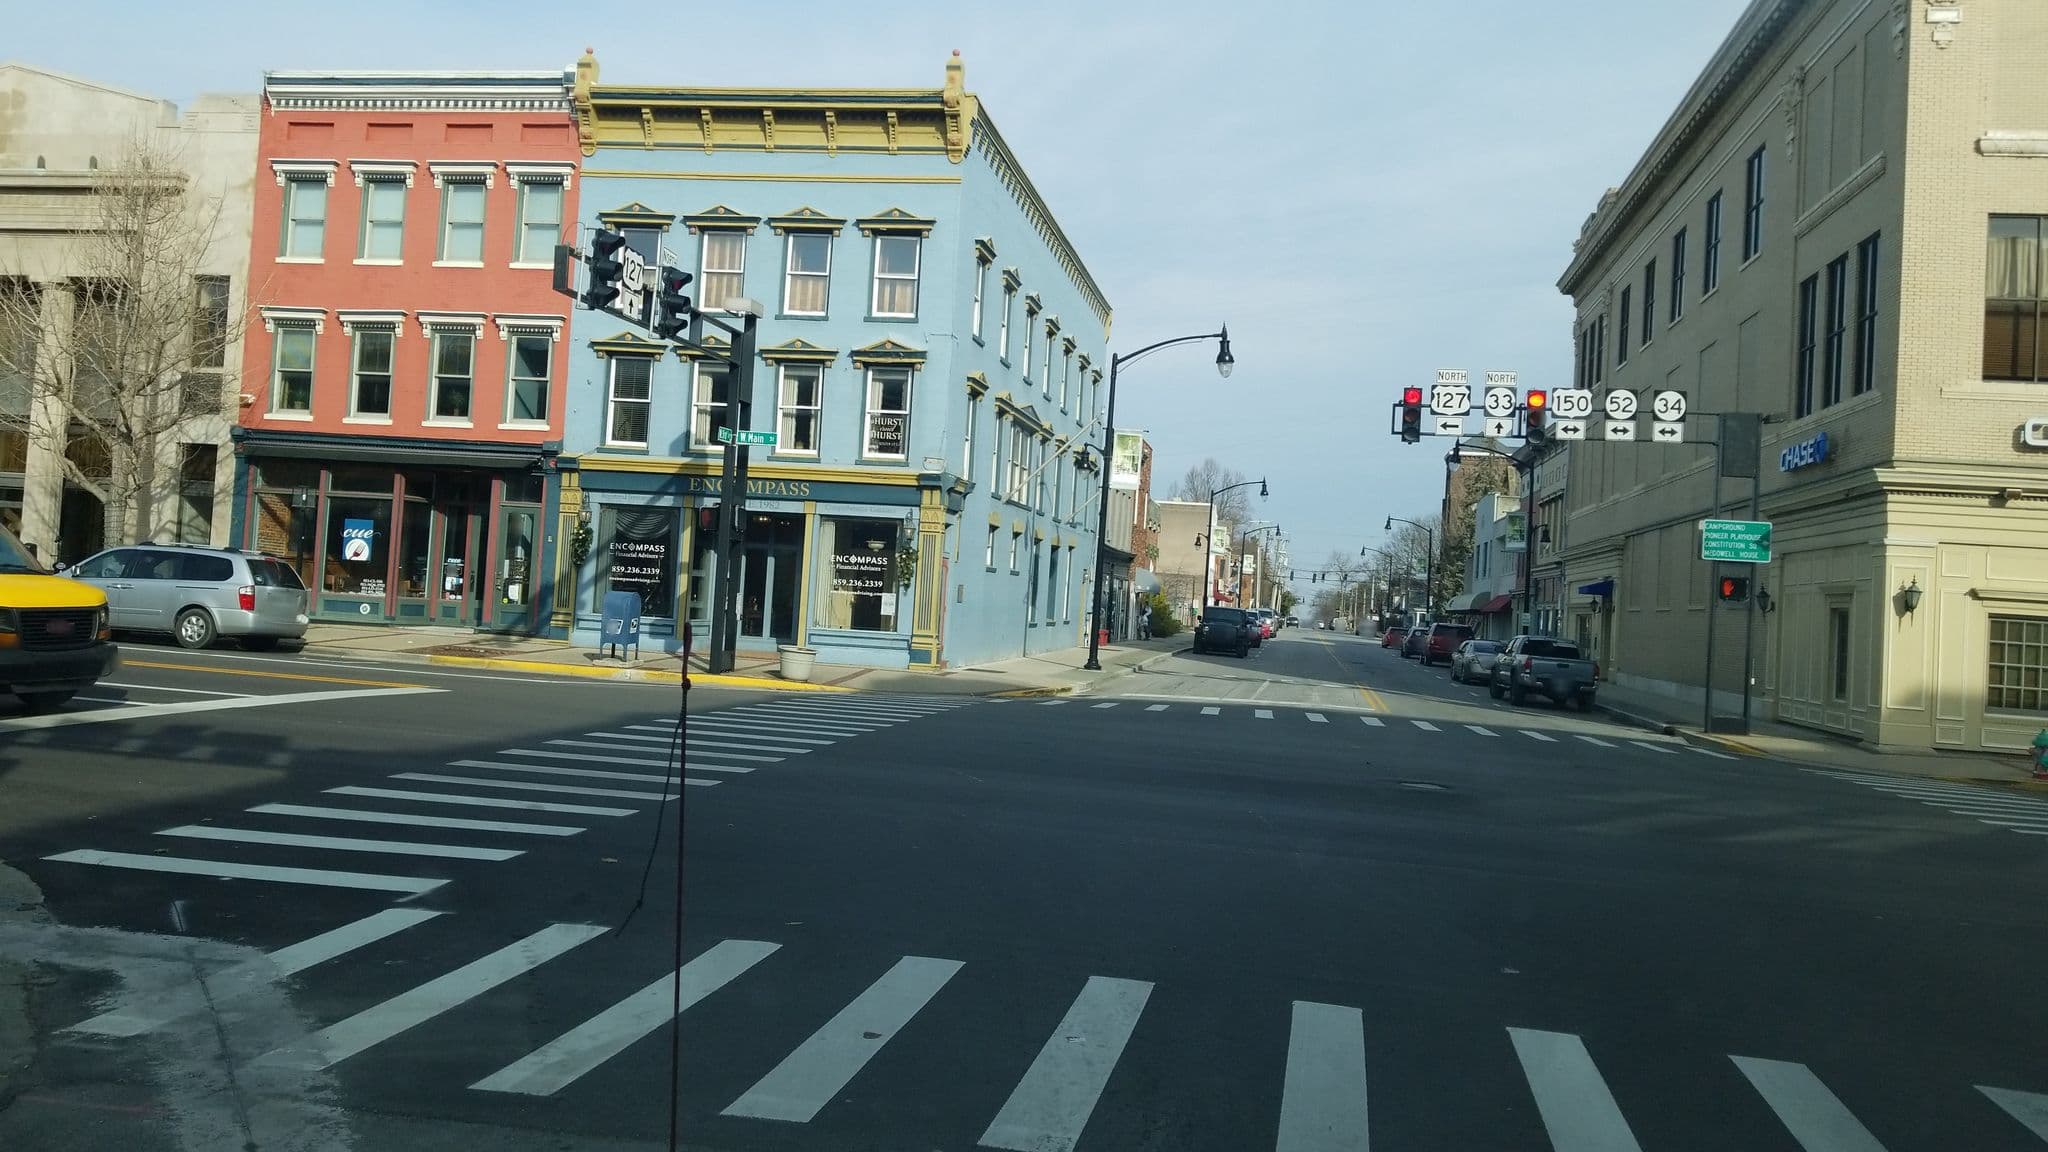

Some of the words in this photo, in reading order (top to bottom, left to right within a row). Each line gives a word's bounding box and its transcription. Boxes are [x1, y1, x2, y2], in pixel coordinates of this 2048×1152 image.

[626, 257, 642, 284] 127
[1438, 371, 1467, 381] NORTH
[1487, 374, 1516, 383] NORTH
[1436, 393, 1466, 409] 127
[1488, 394, 1513, 410] 33
[1556, 395, 1589, 412] 150
[1609, 397, 1633, 413] 52
[1657, 398, 1683, 414] 34
[740, 432, 747, 442] W
[748, 433, 764, 443] Main
[1780, 439, 1815, 472] CHASE
[690, 477, 810, 497] ENMPASS
[1705, 523, 1746, 531] CAMPGROUND
[343, 528, 374, 538] cue
[1730, 533, 1762, 541] PLAYHOUSE
[610, 542, 665, 553] ENCOMPASS
[1704, 541, 1746, 549] CONSTITUTION
[831, 554, 888, 565] ENCOMPASS
[611, 565, 660, 575] 859.236.2339
[833, 578, 883, 588] 859.236.2339
